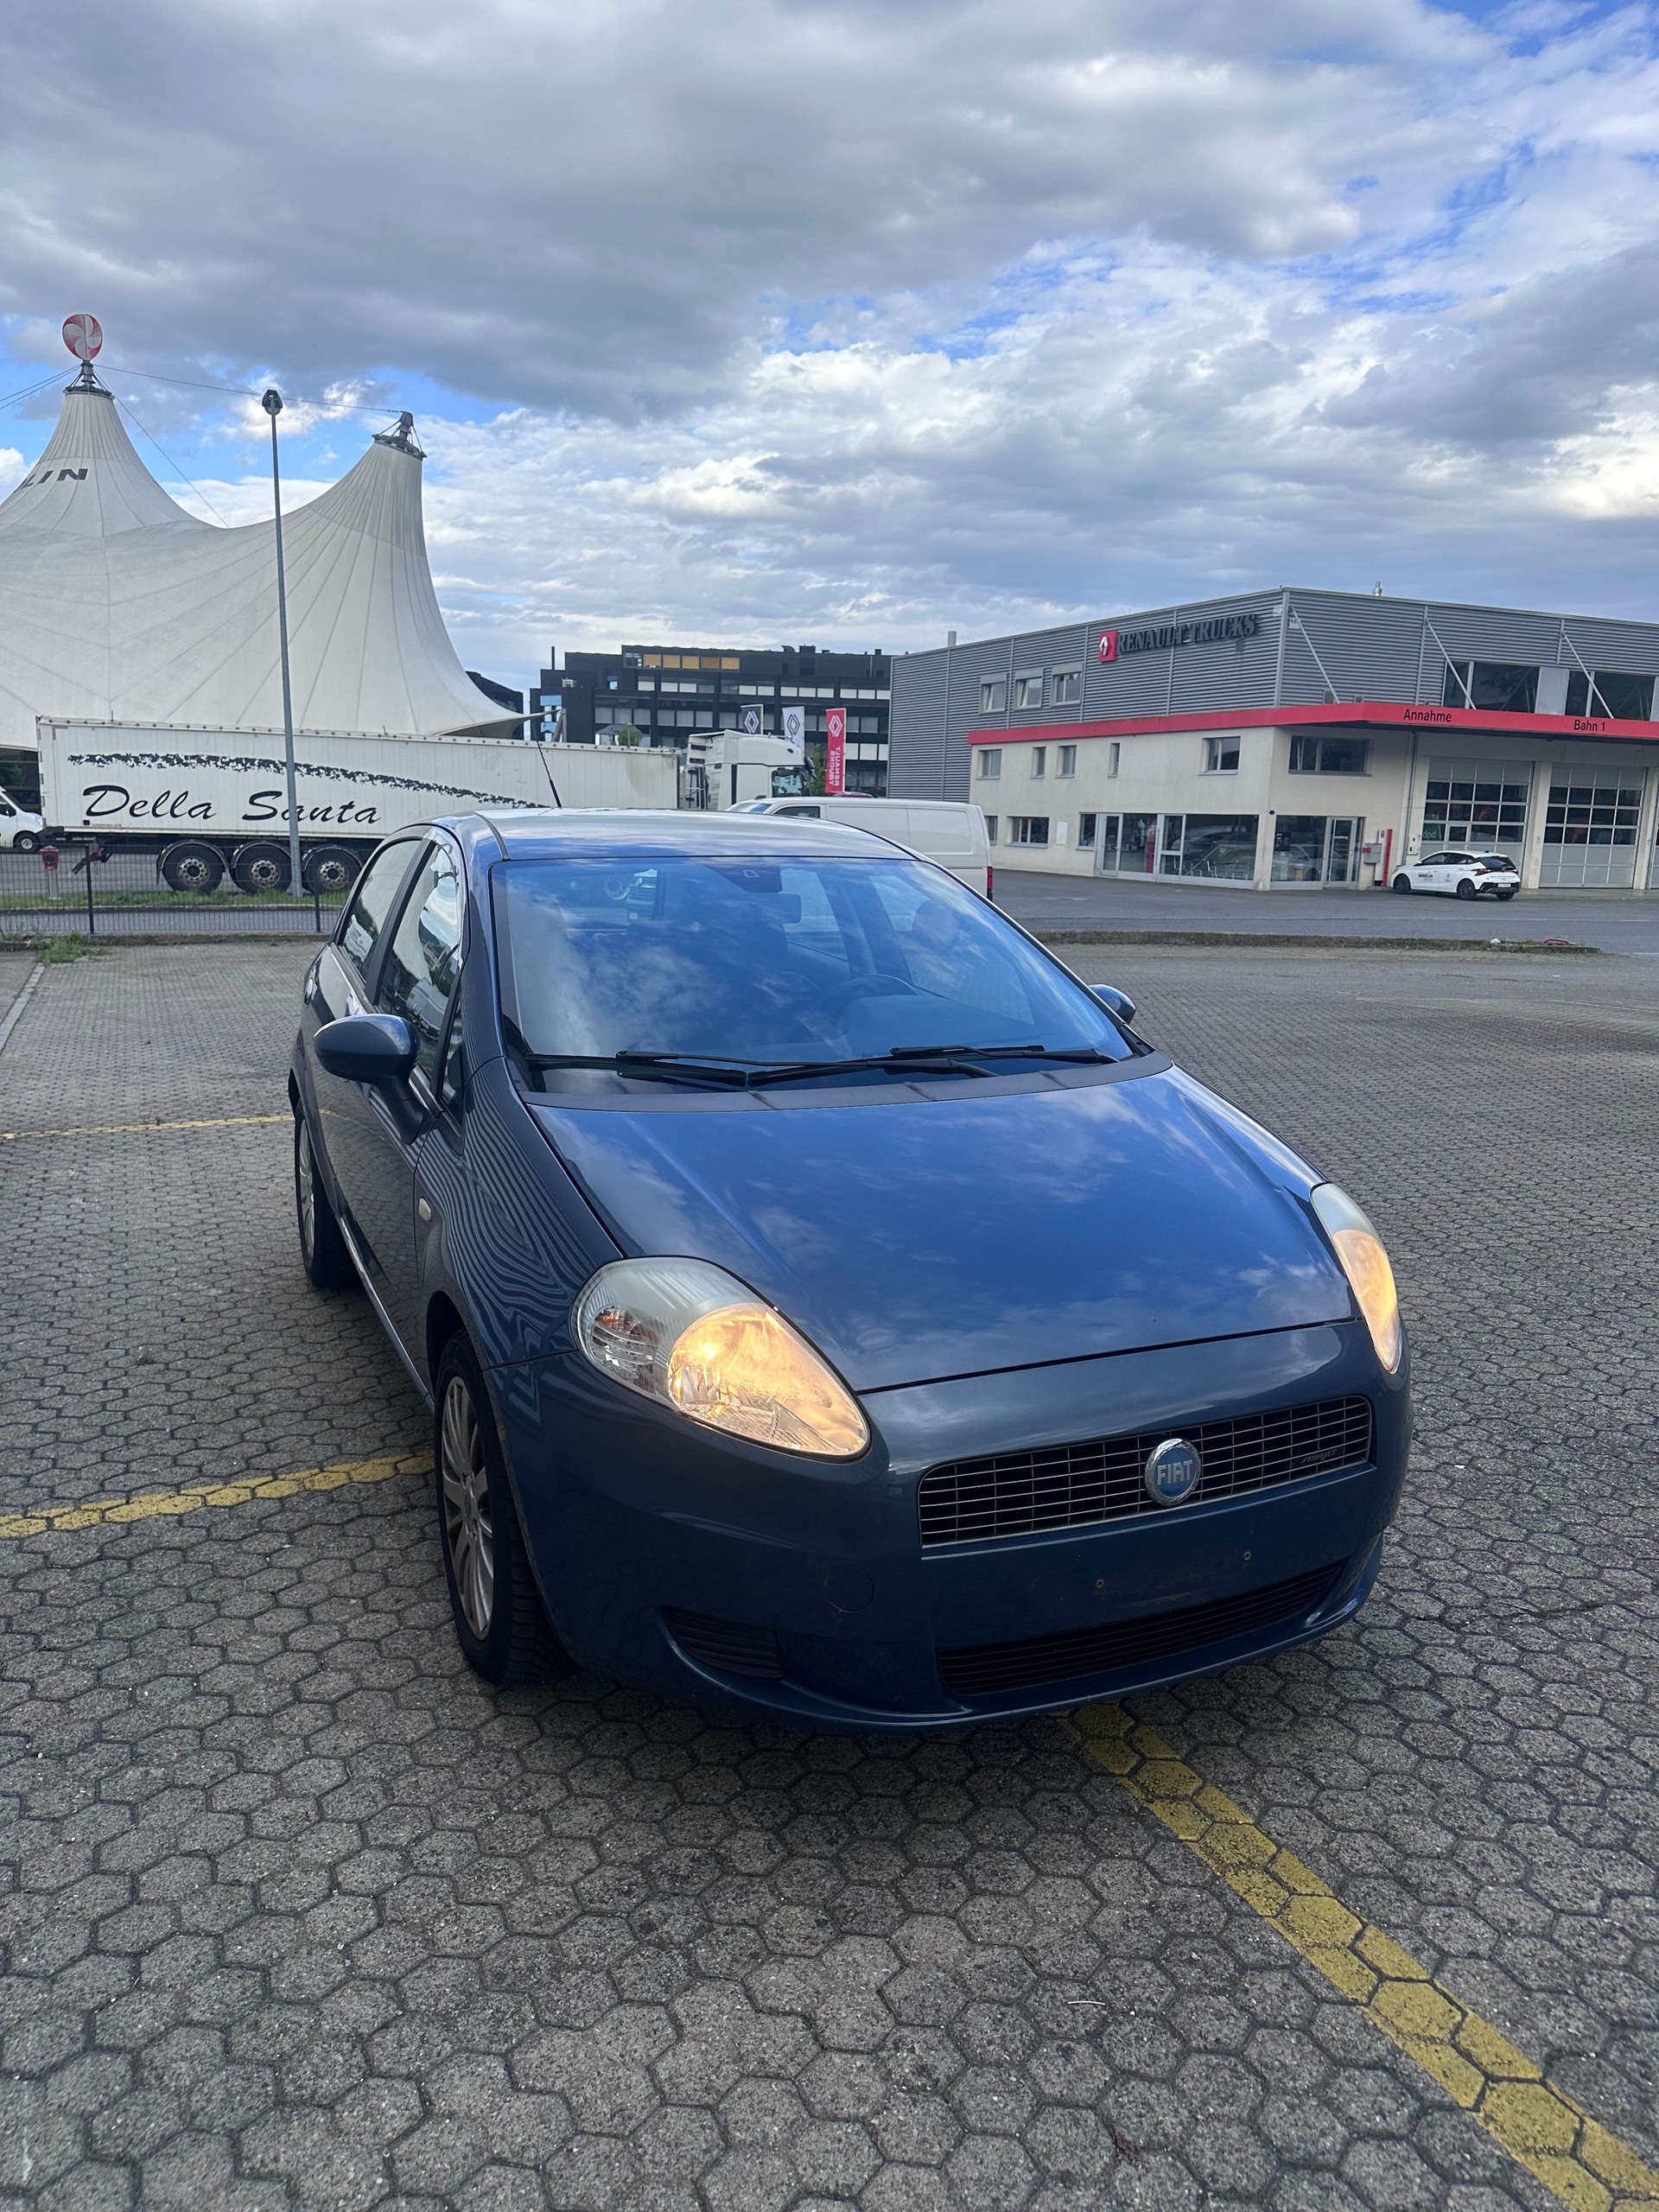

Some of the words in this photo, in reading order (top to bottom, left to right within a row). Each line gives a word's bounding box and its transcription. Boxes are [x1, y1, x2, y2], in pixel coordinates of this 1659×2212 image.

[15, 468, 88, 492] LIN
[1117, 624, 1186, 654] RENAULT
[1188, 613, 1257, 643] TRUCKS
[1403, 709, 1452, 722] Annahme
[1573, 720, 1599, 732] Bahn
[1601, 721, 1605, 732] 1
[82, 785, 217, 819] Della
[242, 791, 382, 823] Santa
[1422, 830, 1437, 841] dpd
[1157, 1459, 1193, 1485] FIAT
